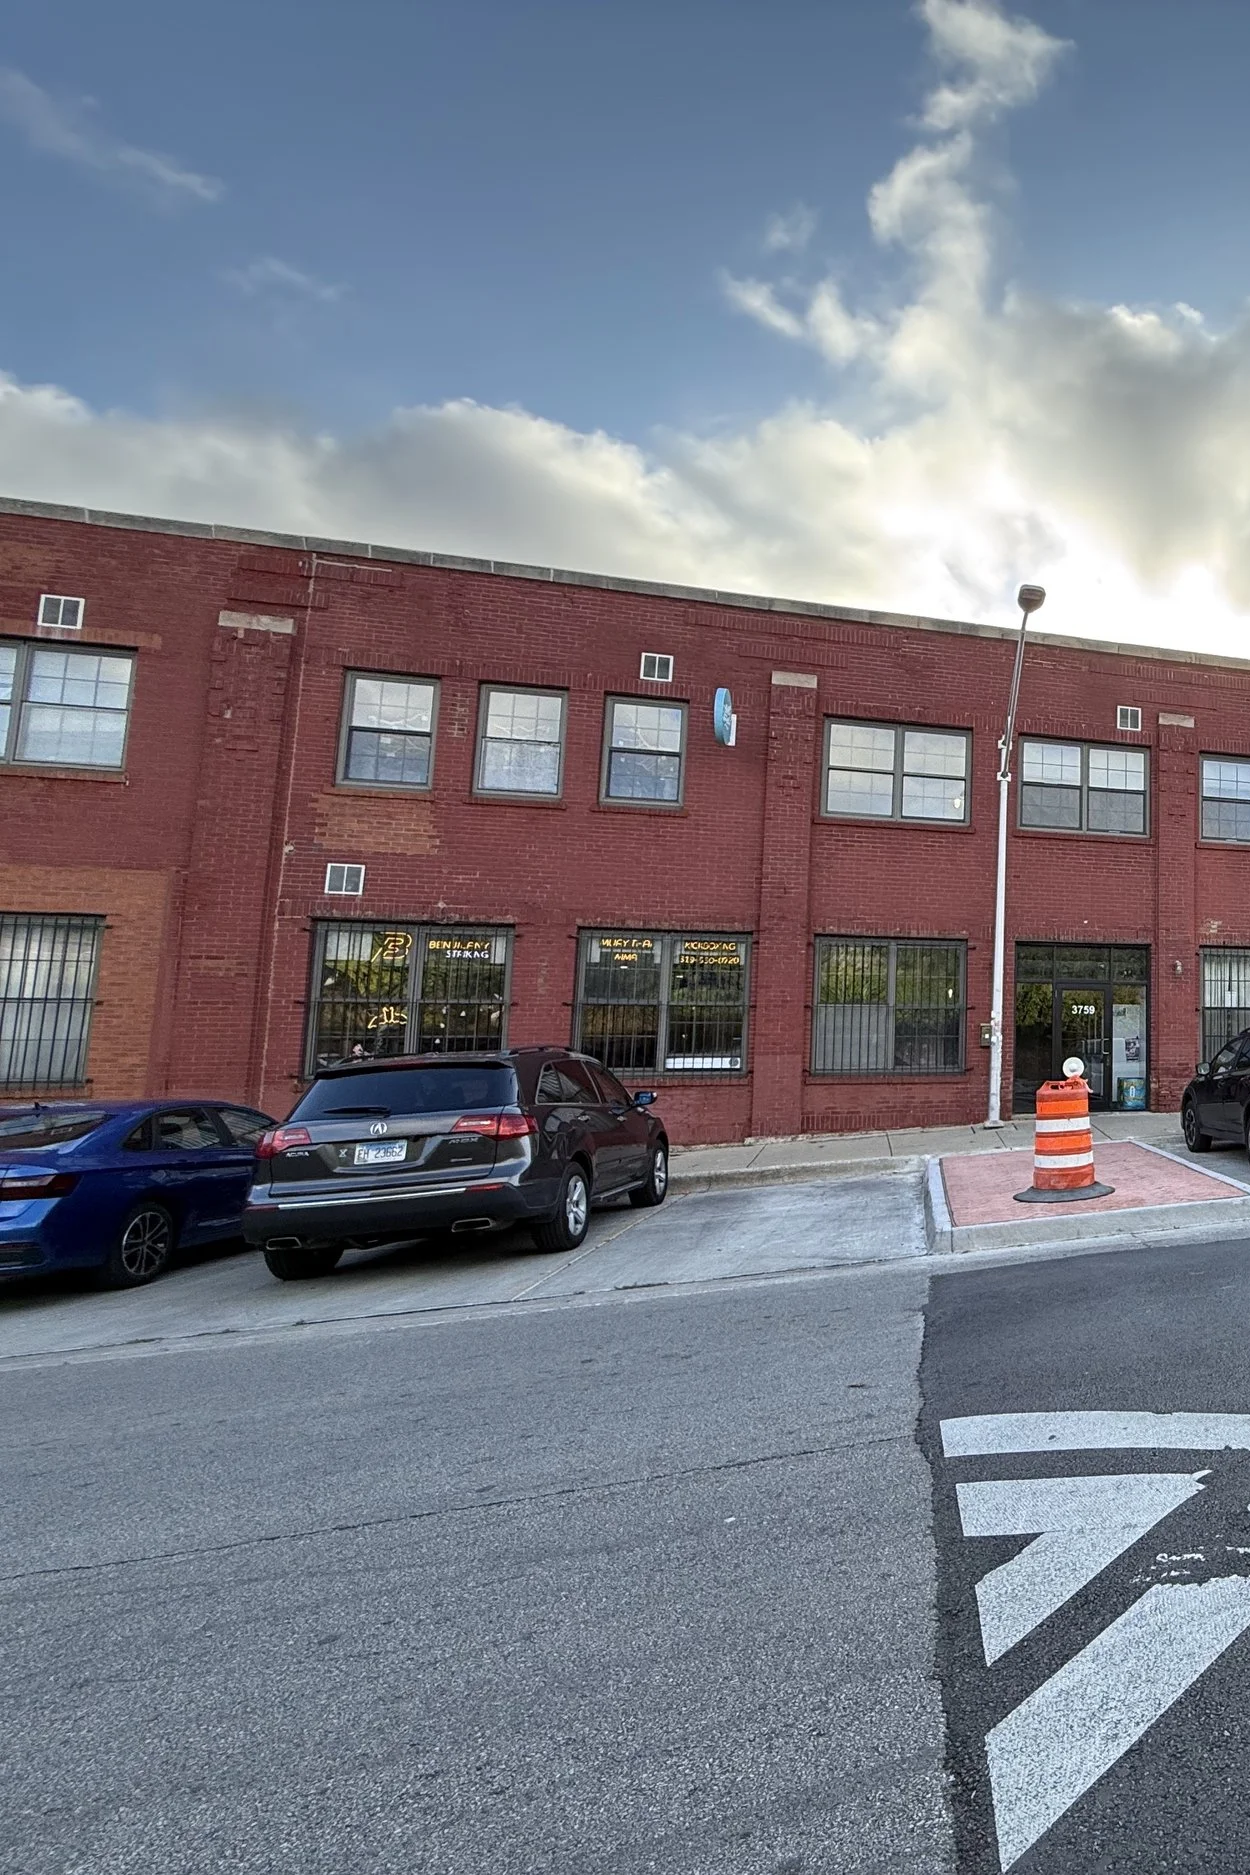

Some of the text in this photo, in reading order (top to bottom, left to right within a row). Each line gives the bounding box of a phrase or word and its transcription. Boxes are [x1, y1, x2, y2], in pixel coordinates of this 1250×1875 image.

[600, 938, 631, 947] MUAY
[684, 941, 736, 951] KICKBOXNG
[445, 949, 490, 959] STRIKNG
[613, 953, 638, 962] MMA
[1071, 1004, 1096, 1015] 3759
[357, 1148, 370, 1160] EH
